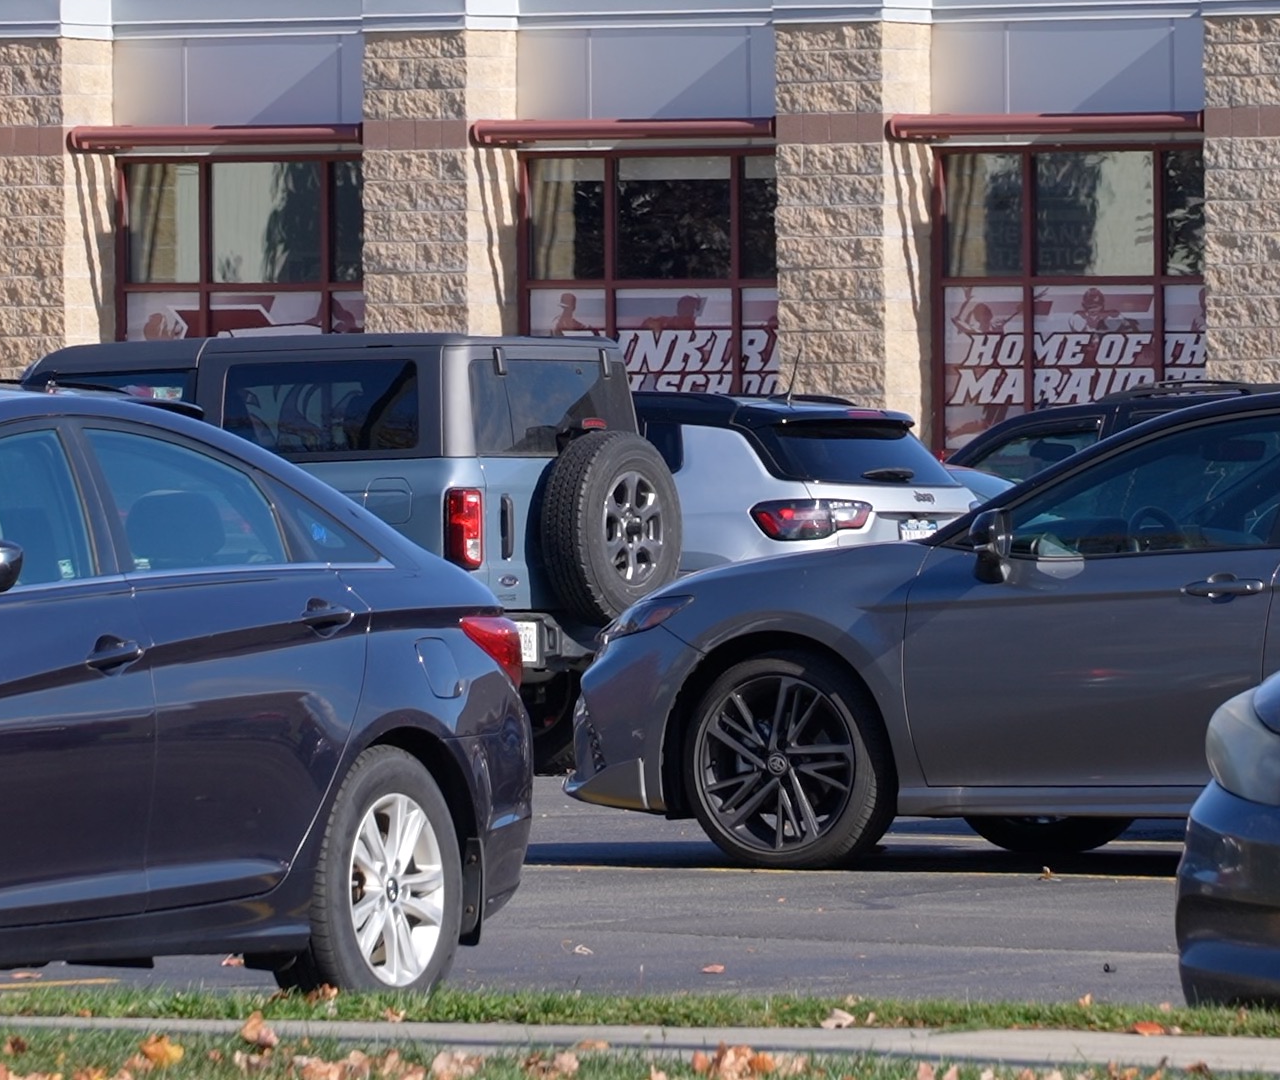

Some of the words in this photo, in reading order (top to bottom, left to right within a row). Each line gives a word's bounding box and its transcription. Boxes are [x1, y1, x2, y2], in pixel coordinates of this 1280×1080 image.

[963, 333, 1091, 366] HOME
[1094, 333, 1152, 366] OF
[1164, 333, 1207, 366] TH
